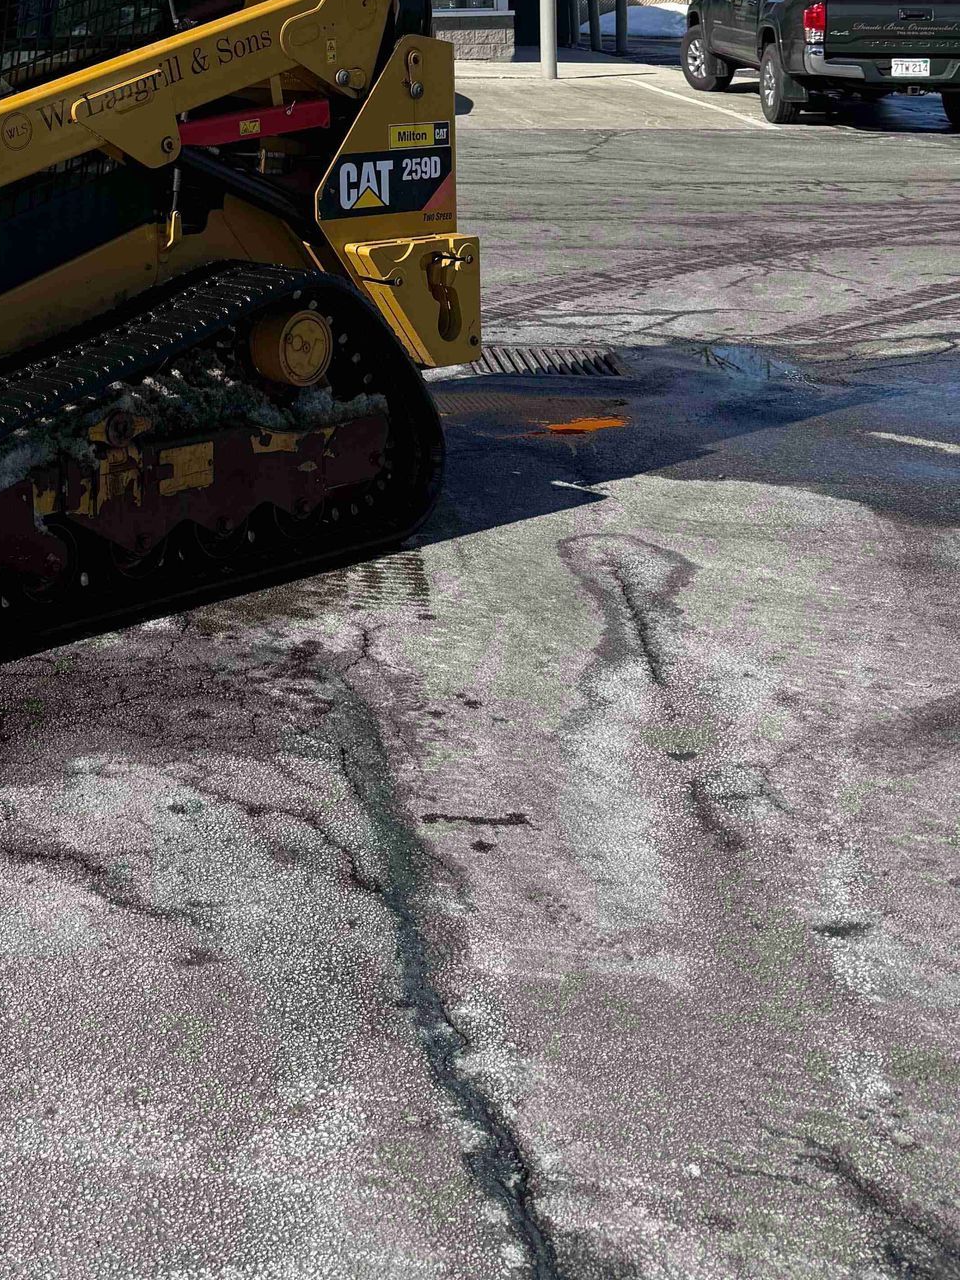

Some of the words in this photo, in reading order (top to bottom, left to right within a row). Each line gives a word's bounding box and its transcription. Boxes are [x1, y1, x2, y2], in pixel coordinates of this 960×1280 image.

[191, 47, 210, 74] &
[216, 29, 272, 65] Sons
[912, 63, 928, 72] 214
[397, 131, 427, 142] Milton
[435, 128, 447, 139] CAT
[340, 160, 394, 210] CAT
[402, 156, 441, 181] 259D
